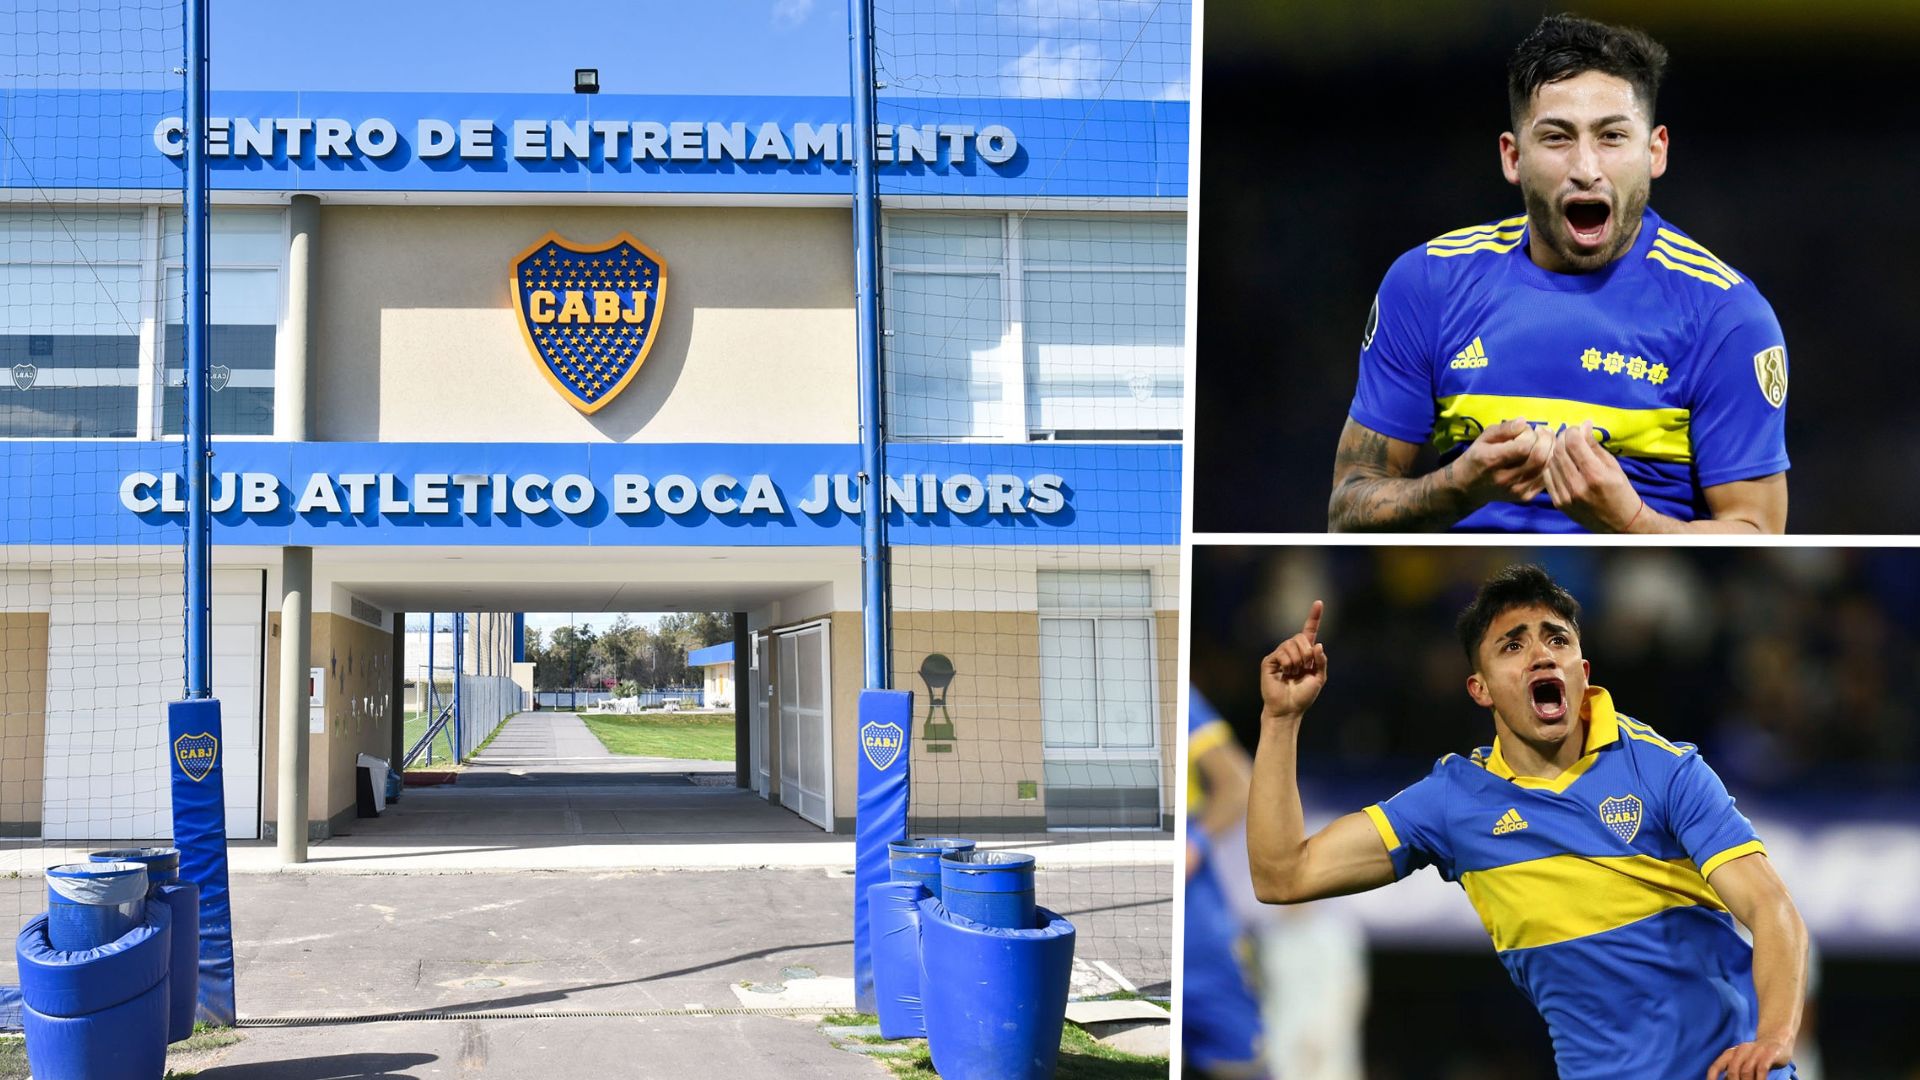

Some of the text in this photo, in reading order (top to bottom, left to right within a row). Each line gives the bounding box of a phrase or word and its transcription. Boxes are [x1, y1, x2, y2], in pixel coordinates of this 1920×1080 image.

[153, 116, 1018, 164] CENTRO DE ENTRENAMIENTO
[529, 289, 648, 324] CABJ
[1451, 357, 1488, 369] adidas
[119, 471, 1066, 515] CLUB ATLETICO BOCA JUNIORS
[866, 736, 898, 748] CABJ
[180, 749, 212, 758] CABJ
[1606, 811, 1638, 824] CABJ
[1492, 820, 1528, 834] adidas
